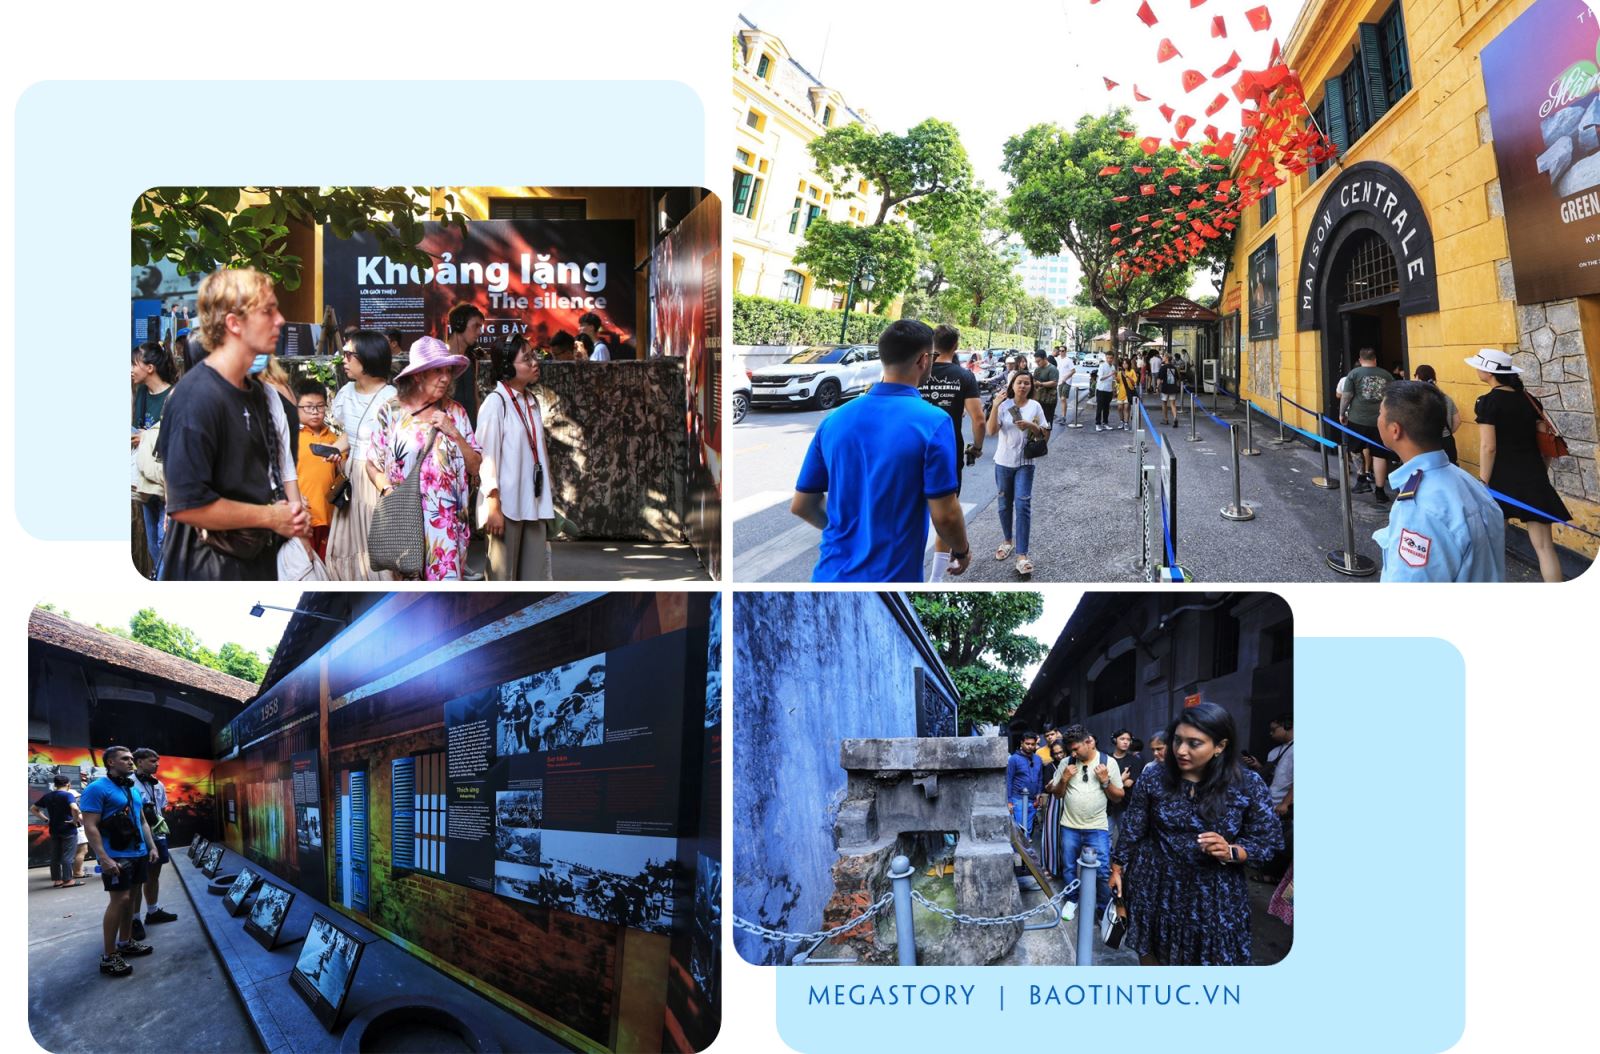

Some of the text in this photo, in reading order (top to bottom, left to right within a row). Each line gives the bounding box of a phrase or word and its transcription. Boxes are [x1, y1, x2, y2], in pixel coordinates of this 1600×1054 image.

[1560, 192, 1600, 224] GREEN
[1303, 181, 1425, 310] MAISON CENTRALE
[357, 251, 606, 292] Khoảng lặng
[488, 292, 607, 309] The silence
[261, 698, 279, 721] 1958
